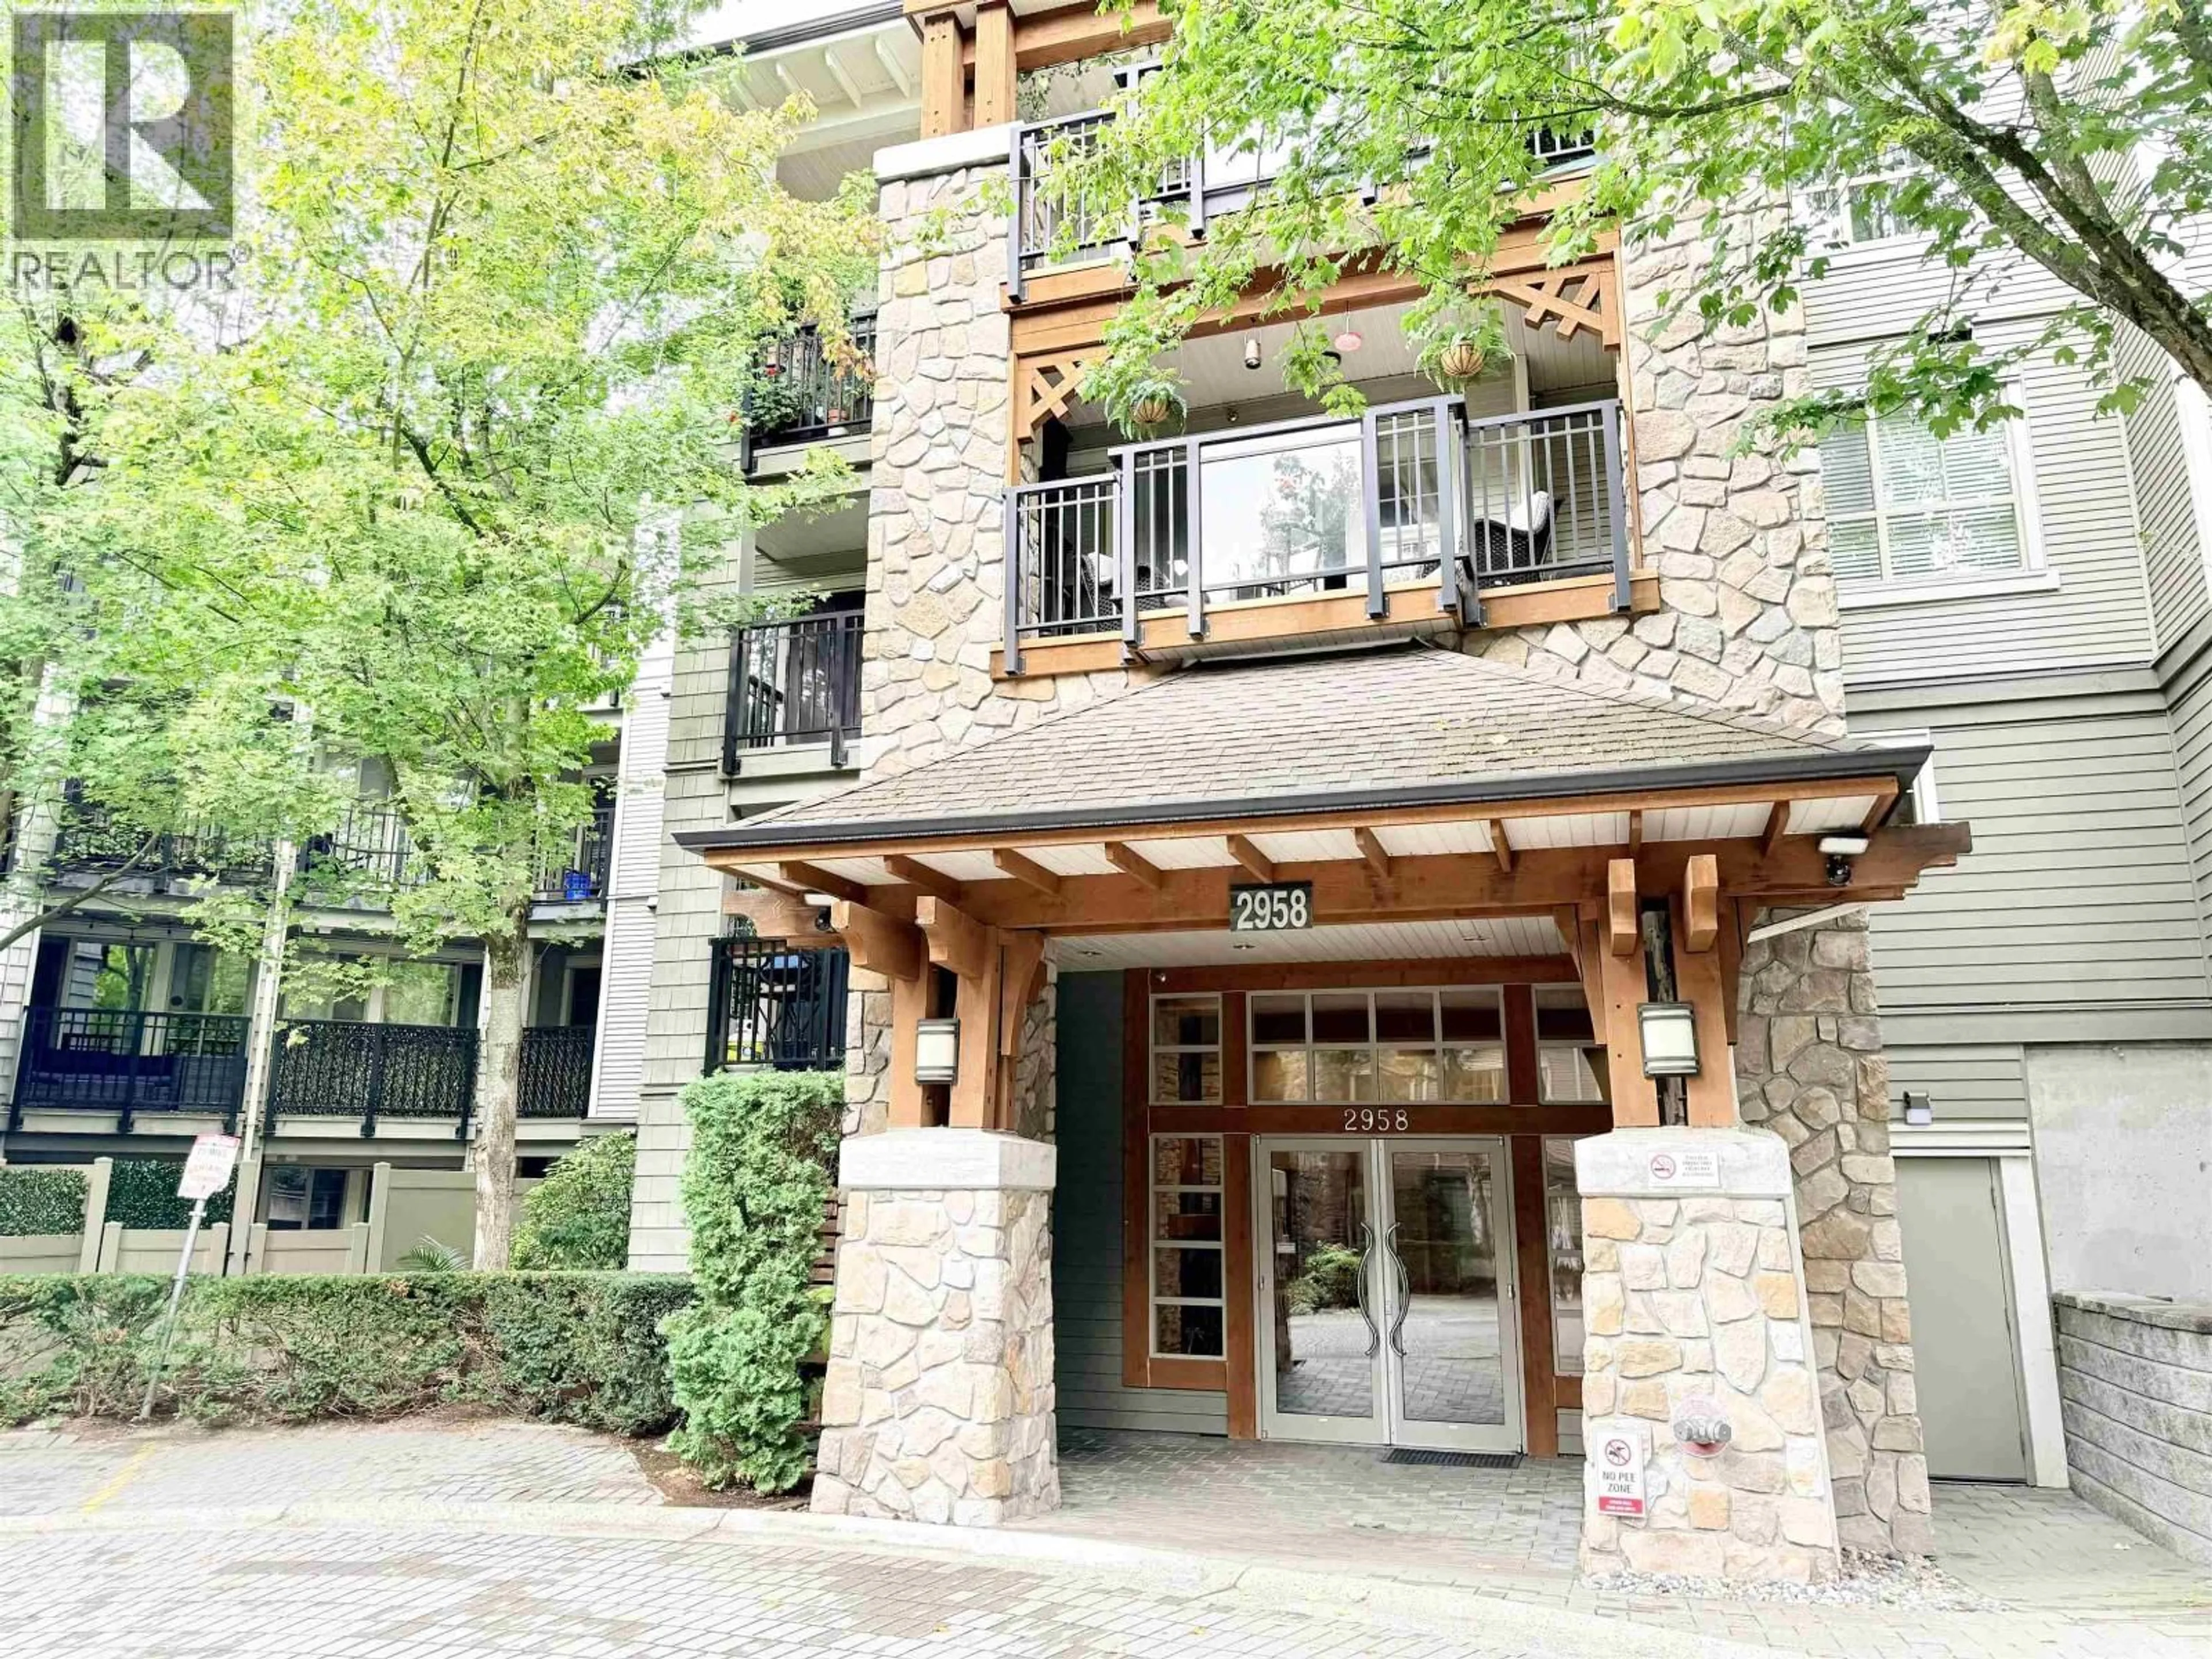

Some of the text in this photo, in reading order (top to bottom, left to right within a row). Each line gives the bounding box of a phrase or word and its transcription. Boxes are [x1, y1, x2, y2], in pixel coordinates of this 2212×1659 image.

[1237, 889, 1308, 930] 2958
[1344, 1108, 1409, 1131] 2958
[1603, 1471, 1636, 1483] NO PEE
[1608, 1483, 1633, 1494] ZONE
